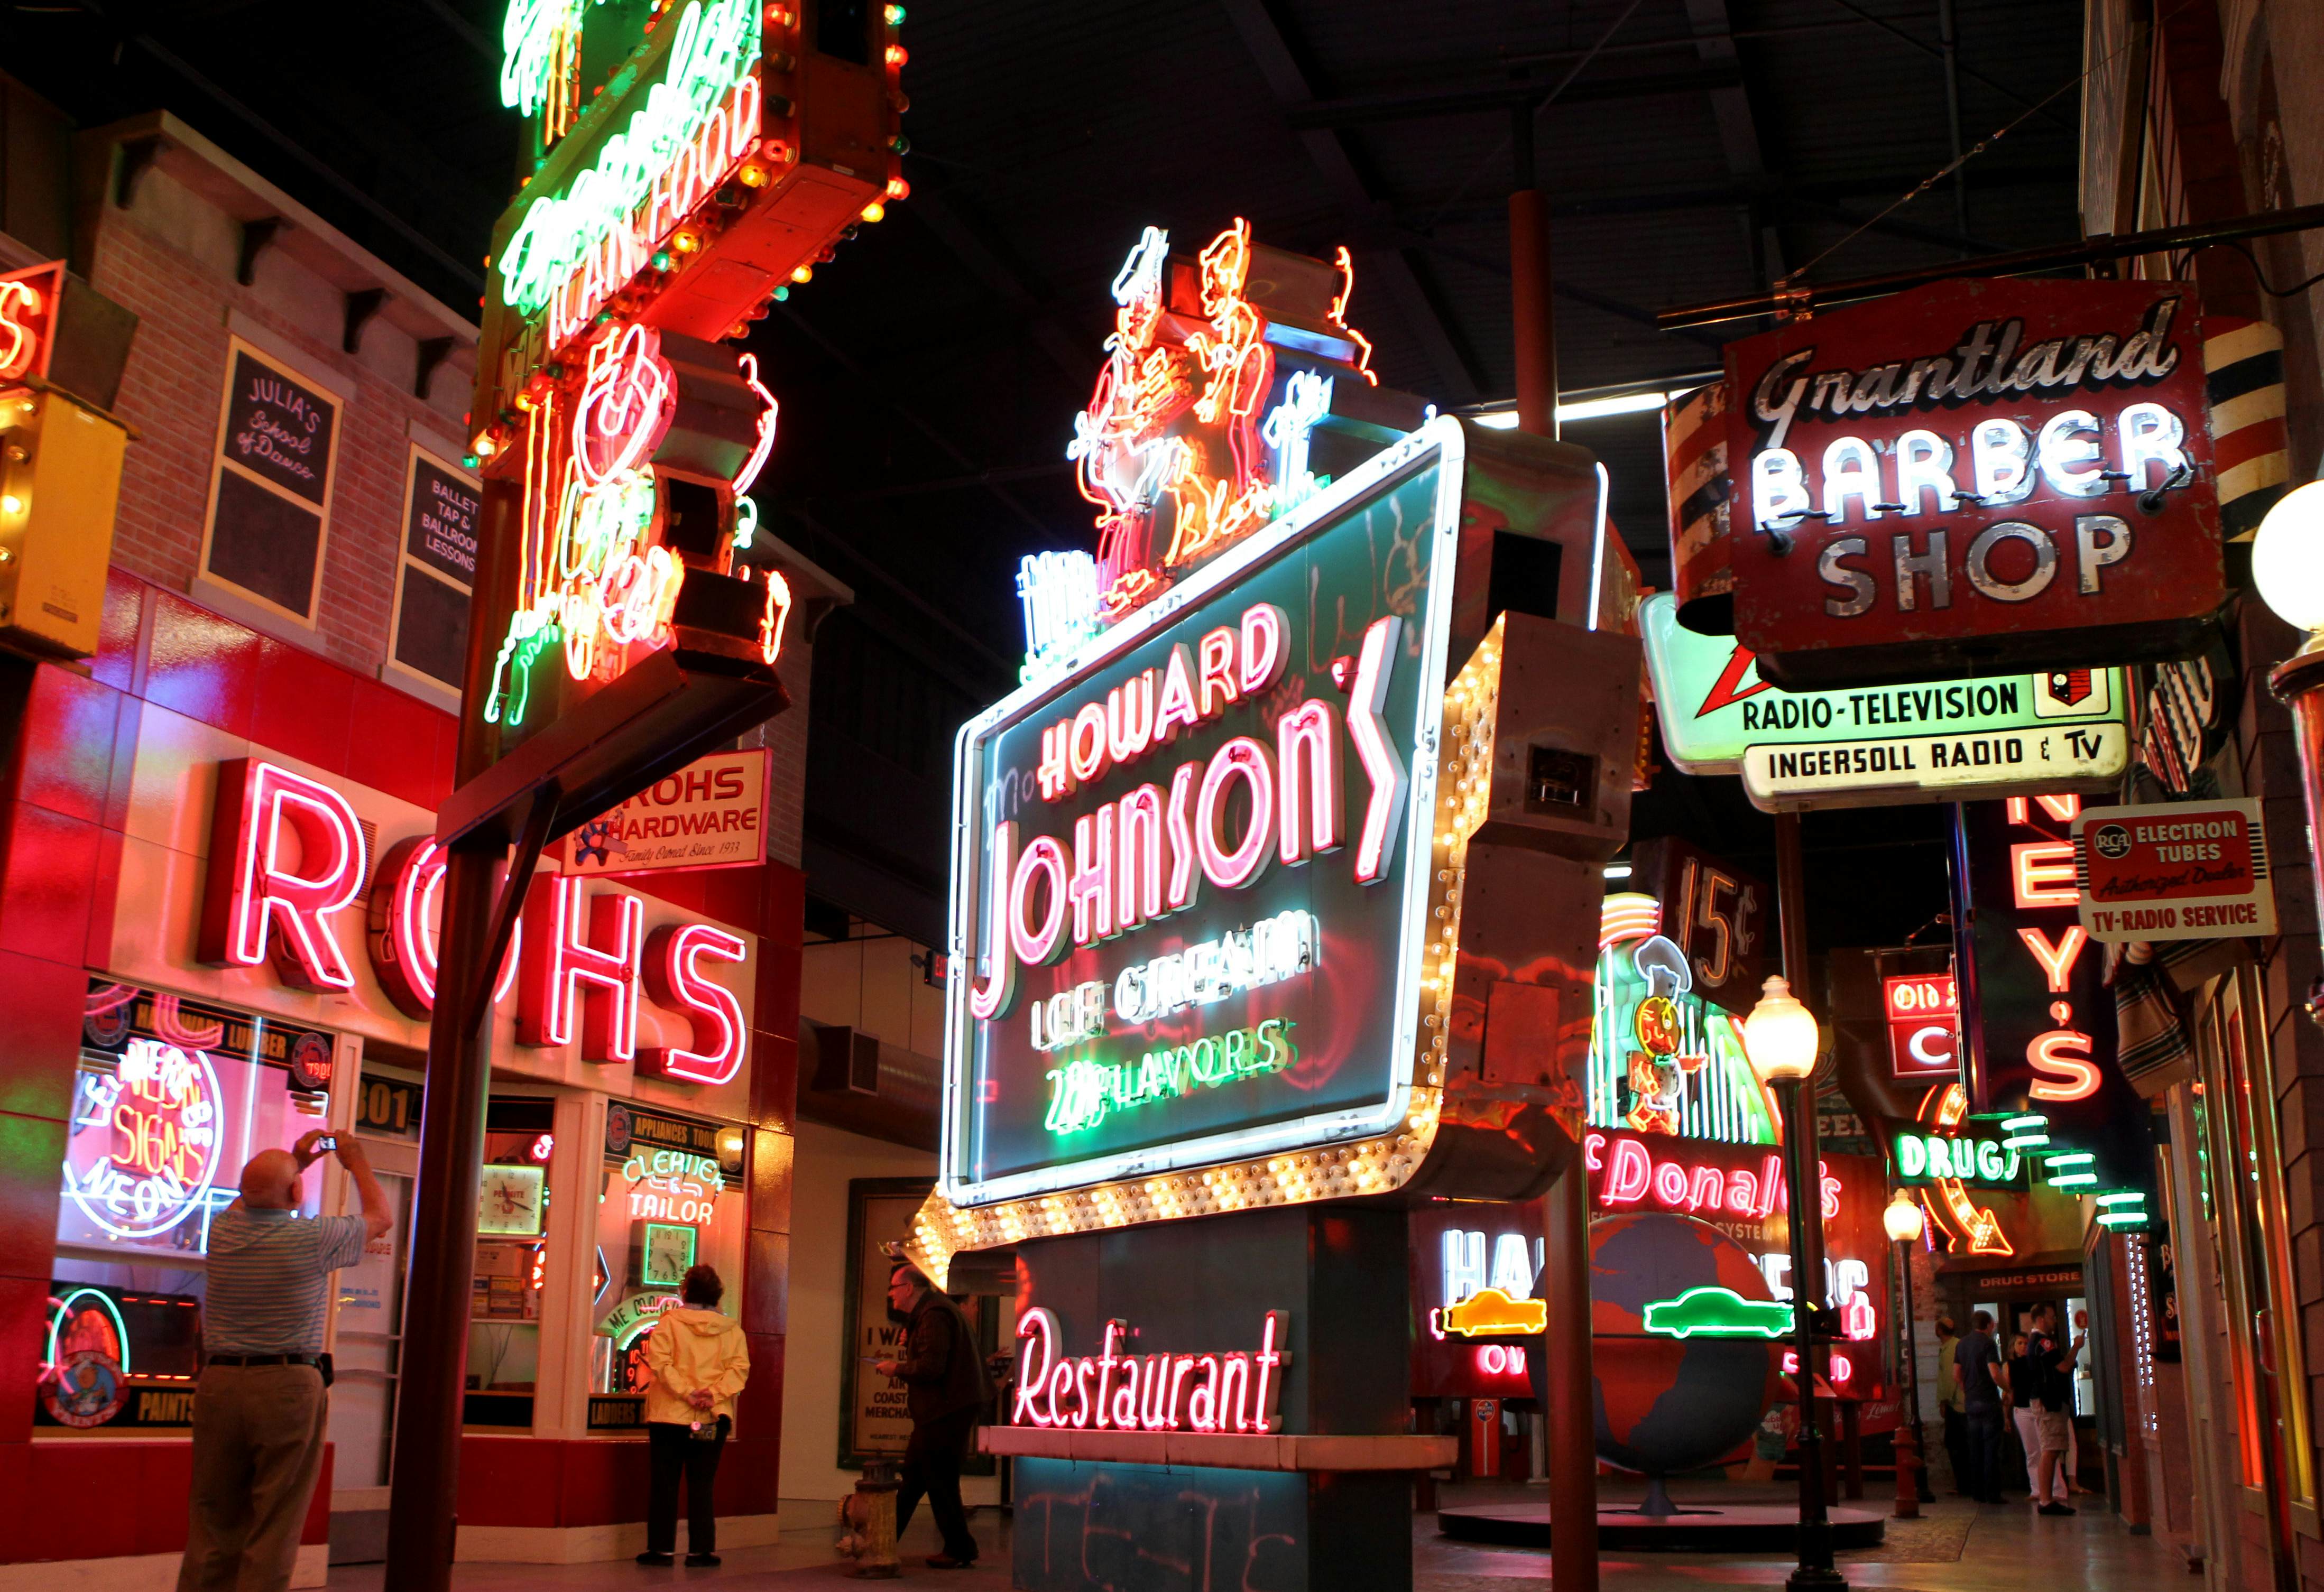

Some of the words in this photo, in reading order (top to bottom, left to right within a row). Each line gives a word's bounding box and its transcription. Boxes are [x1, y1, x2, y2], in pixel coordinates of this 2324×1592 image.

[1753, 295, 2181, 450] Grantland
[248, 378, 320, 433] JULIA'S
[250, 410, 312, 454] School
[236, 431, 256, 455] of
[256, 435, 315, 479] Dance
[1752, 403, 2193, 532] BARBER
[431, 479, 478, 515] BALLET
[437, 500, 459, 522] TAP
[461, 516, 471, 530] &
[426, 533, 476, 572] LESSONS
[1819, 514, 2134, 617] SHOP
[1037, 602, 1291, 802] HOWARD
[1742, 682, 2019, 731] RADIO-TELEVISION
[1769, 744, 1915, 779] INGERSOLL
[1932, 738, 2023, 769] RADIO
[2064, 730, 2102, 760] TV
[610, 807, 758, 841] HARDWARE
[971, 615, 1410, 1021] JOHNSON'S
[2097, 833, 2131, 848] RCA
[2136, 820, 2238, 843] ELECTRON
[620, 847, 654, 866] Family
[655, 845, 687, 860] Owned
[689, 843, 715, 857] Since
[718, 841, 740, 855] 1933
[2156, 843, 2221, 863] TUBES
[2099, 868, 2190, 897] Authorized
[2191, 861, 2246, 884] Dealer
[2092, 907, 2178, 933] TV-RADIO
[2182, 902, 2258, 928] SERVICE
[635, 1117, 687, 1144] APPLIANCES
[693, 1127, 715, 1150] TOOL
[82, 1156, 185, 1221] NEON
[630, 1193, 713, 1226] TAILOR
[1715, 1221, 1773, 1241] SYSTEM
[1980, 1275, 2024, 1288] DRUG
[2026, 1271, 2080, 1285] STORE
[1012, 1307, 1284, 1434] Restaurant
[865, 1406, 910, 1419] MERCHA
[873, 1392, 908, 1404] COAST
